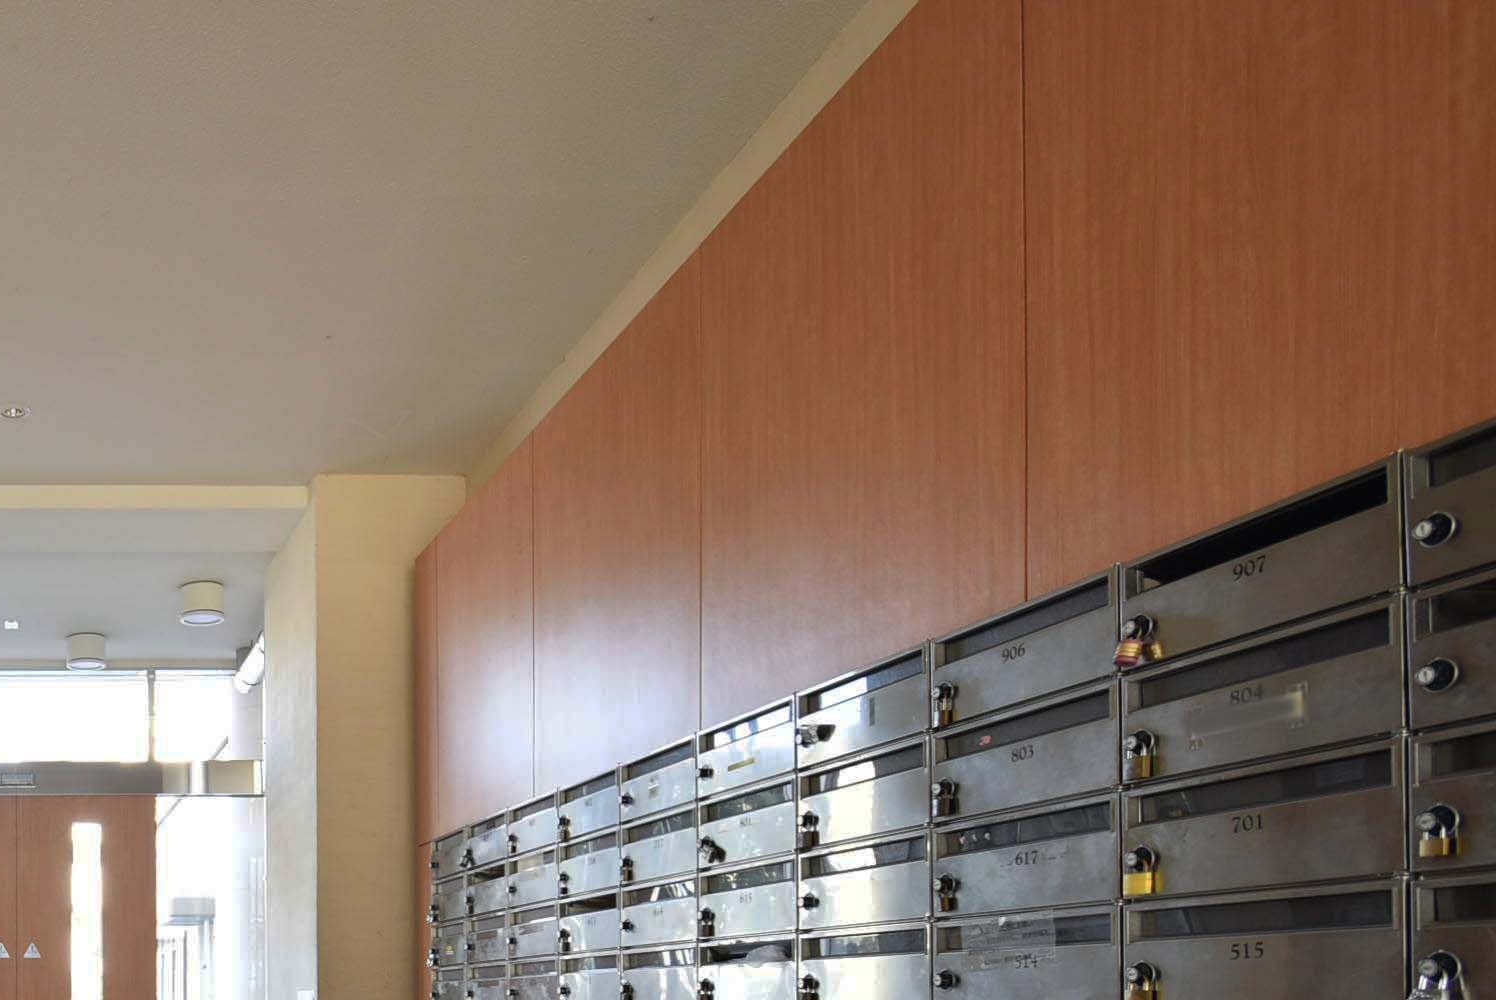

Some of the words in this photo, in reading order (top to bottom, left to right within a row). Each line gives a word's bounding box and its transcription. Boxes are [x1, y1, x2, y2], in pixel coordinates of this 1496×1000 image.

[1232, 554, 1266, 581] 907
[1002, 643, 1026, 662] 906
[1229, 684, 1264, 705] 804
[1011, 745, 1034, 762] 803
[1232, 813, 1264, 833] 701
[1015, 850, 1039, 866] 617
[1230, 941, 1264, 960] 515
